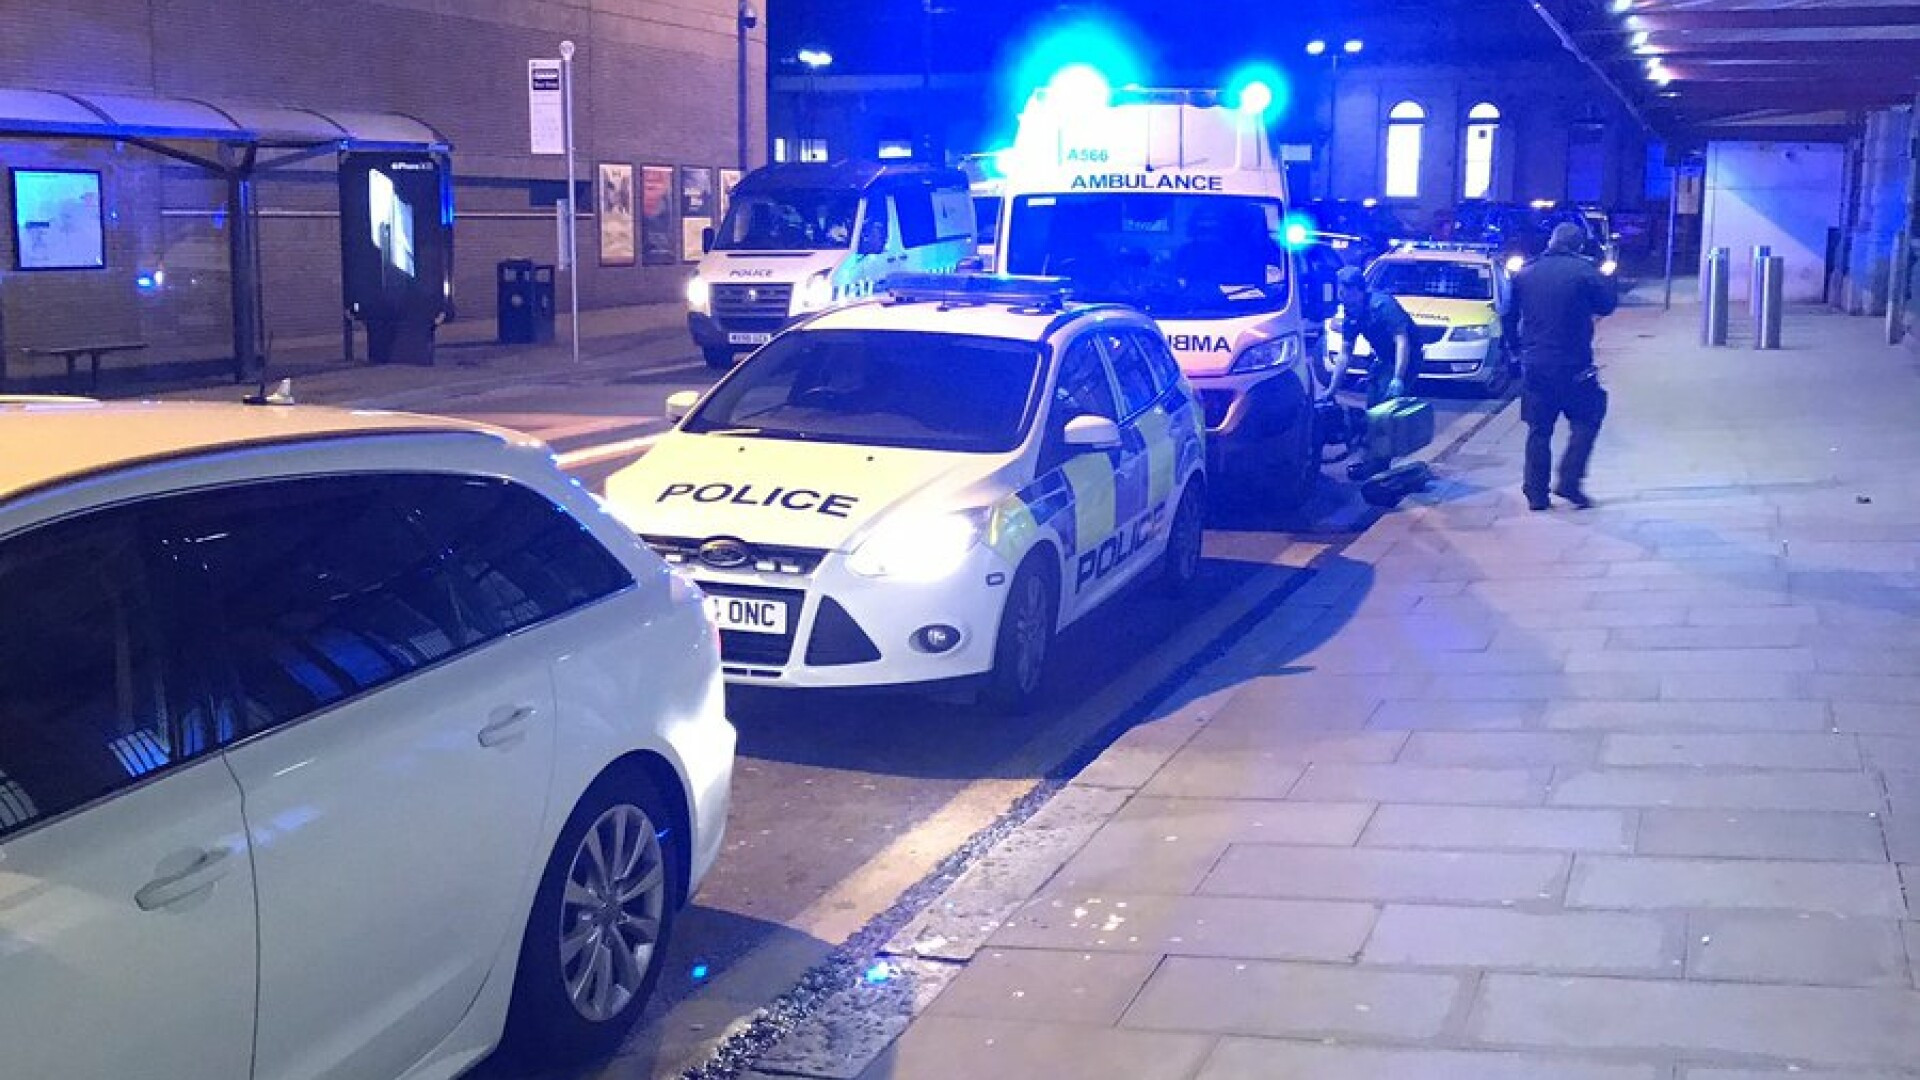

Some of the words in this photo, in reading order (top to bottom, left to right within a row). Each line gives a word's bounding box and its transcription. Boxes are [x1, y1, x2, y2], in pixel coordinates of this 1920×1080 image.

[1071, 174, 1223, 191] AMBULANCE
[729, 269, 773, 278] POLICE
[656, 483, 859, 518] POLICE
[1075, 501, 1165, 595] POLICE
